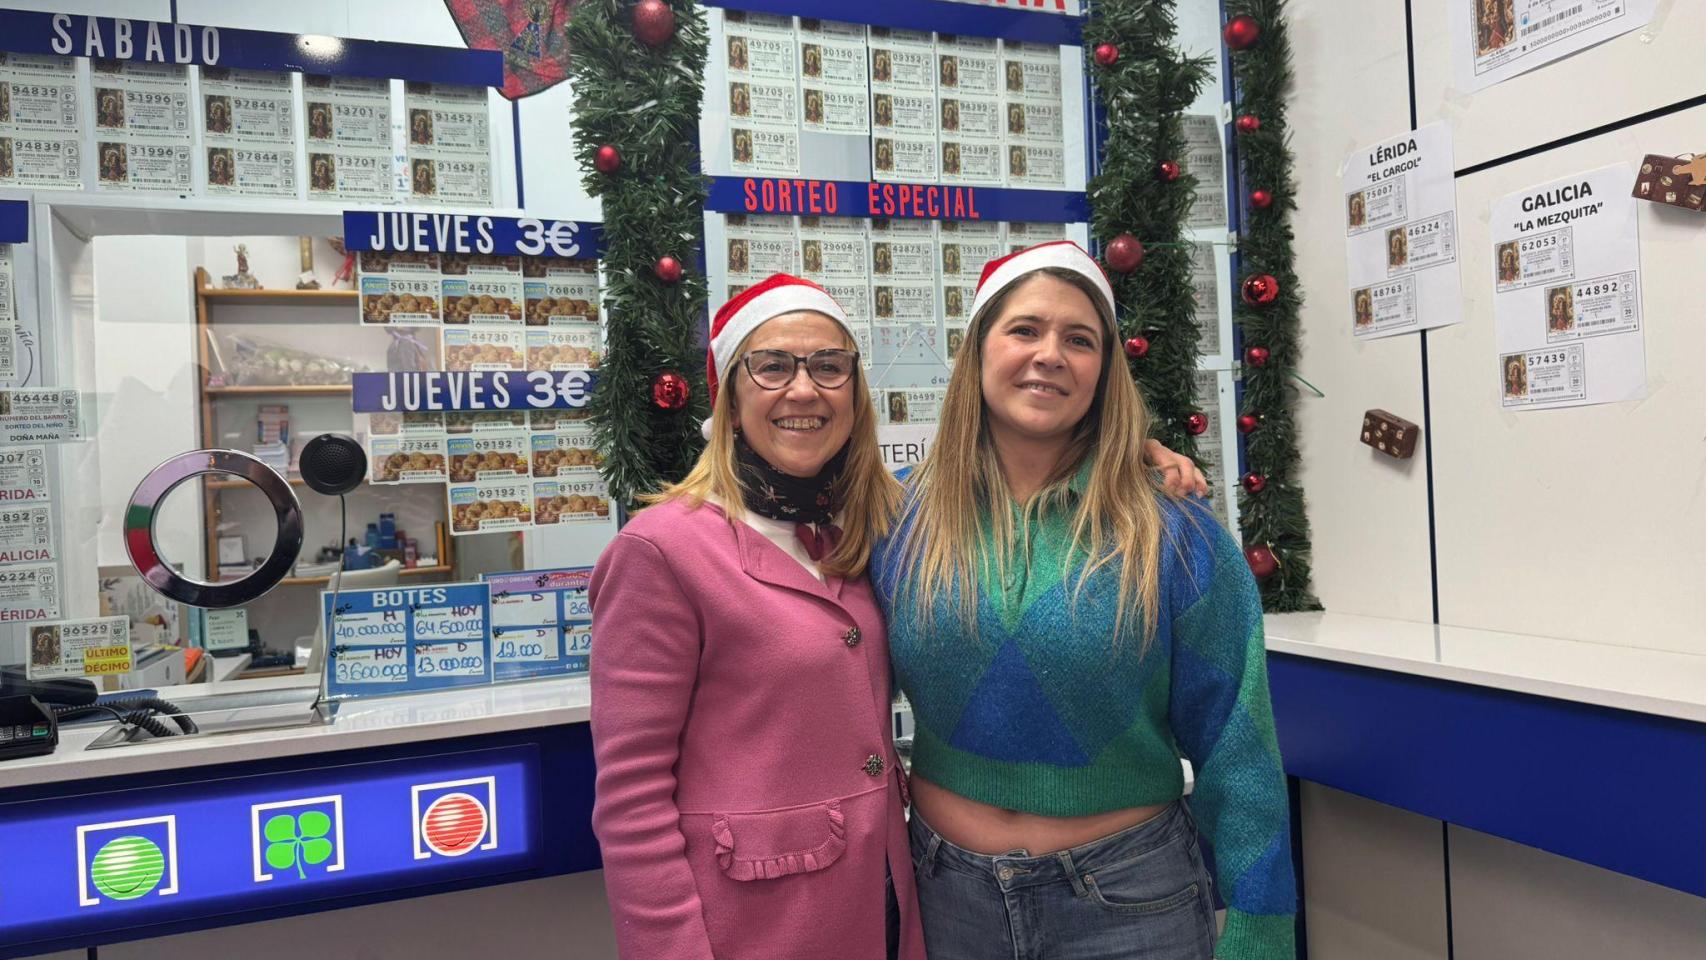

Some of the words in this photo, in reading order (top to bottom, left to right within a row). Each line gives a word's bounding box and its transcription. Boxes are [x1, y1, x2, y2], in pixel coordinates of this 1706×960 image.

[51, 14, 220, 66] SABADO
[750, 40, 781, 51] 49705
[12, 86, 58, 96] 94839
[752, 86, 783, 97] 49705
[127, 92, 171, 103] 31996
[234, 99, 275, 109] 97844
[336, 106, 373, 116] 13701
[435, 113, 473, 122] 91452
[754, 132, 785, 142] 49705
[15, 141, 60, 151] 94839
[130, 147, 173, 156] 31996
[237, 151, 278, 160] 97844
[1370, 138, 1417, 166] LÉRIDA
[338, 157, 376, 167] 13701
[1366, 184, 1392, 199] 75007
[1521, 181, 1592, 212] GALICIA
[743, 178, 838, 214] SORTEO
[868, 182, 980, 219] ESPECIAL
[370, 212, 494, 254] JUEVES
[515, 218, 580, 257] 3€
[1408, 221, 1439, 237] 46224
[1521, 236, 1557, 251] 62053
[390, 282, 428, 291] 50183
[469, 283, 506, 293] 44730
[549, 286, 584, 295] 76868
[1373, 284, 1402, 298] 48763
[1576, 282, 1618, 297] 44892
[471, 333, 508, 342] 44730
[1528, 352, 1565, 366] 57439
[382, 371, 510, 411] JUEVES
[526, 370, 591, 408] 3€
[13, 393, 59, 402] 46448
[10, 433, 34, 441] DOÑA
[36, 432, 60, 440] MAÑA
[558, 437, 592, 446] 81057
[401, 441, 438, 450] 27344
[475, 440, 512, 449] 69192
[878, 437, 926, 463] TERÍ
[0, 453, 24, 463] 007
[478, 488, 515, 497] 69192
[560, 484, 594, 492] 81057
[0, 488, 35, 500] RIDA
[0, 512, 30, 521] 892
[0, 549, 50, 562] ALICIA
[0, 571, 35, 581] 6224
[372, 588, 447, 608] BOTES
[0, 607, 47, 621] ÉRIDA
[451, 605, 477, 617] HOY
[63, 624, 107, 635] 96529
[374, 647, 402, 660] HOY
[496, 641, 542, 658] 12.000
